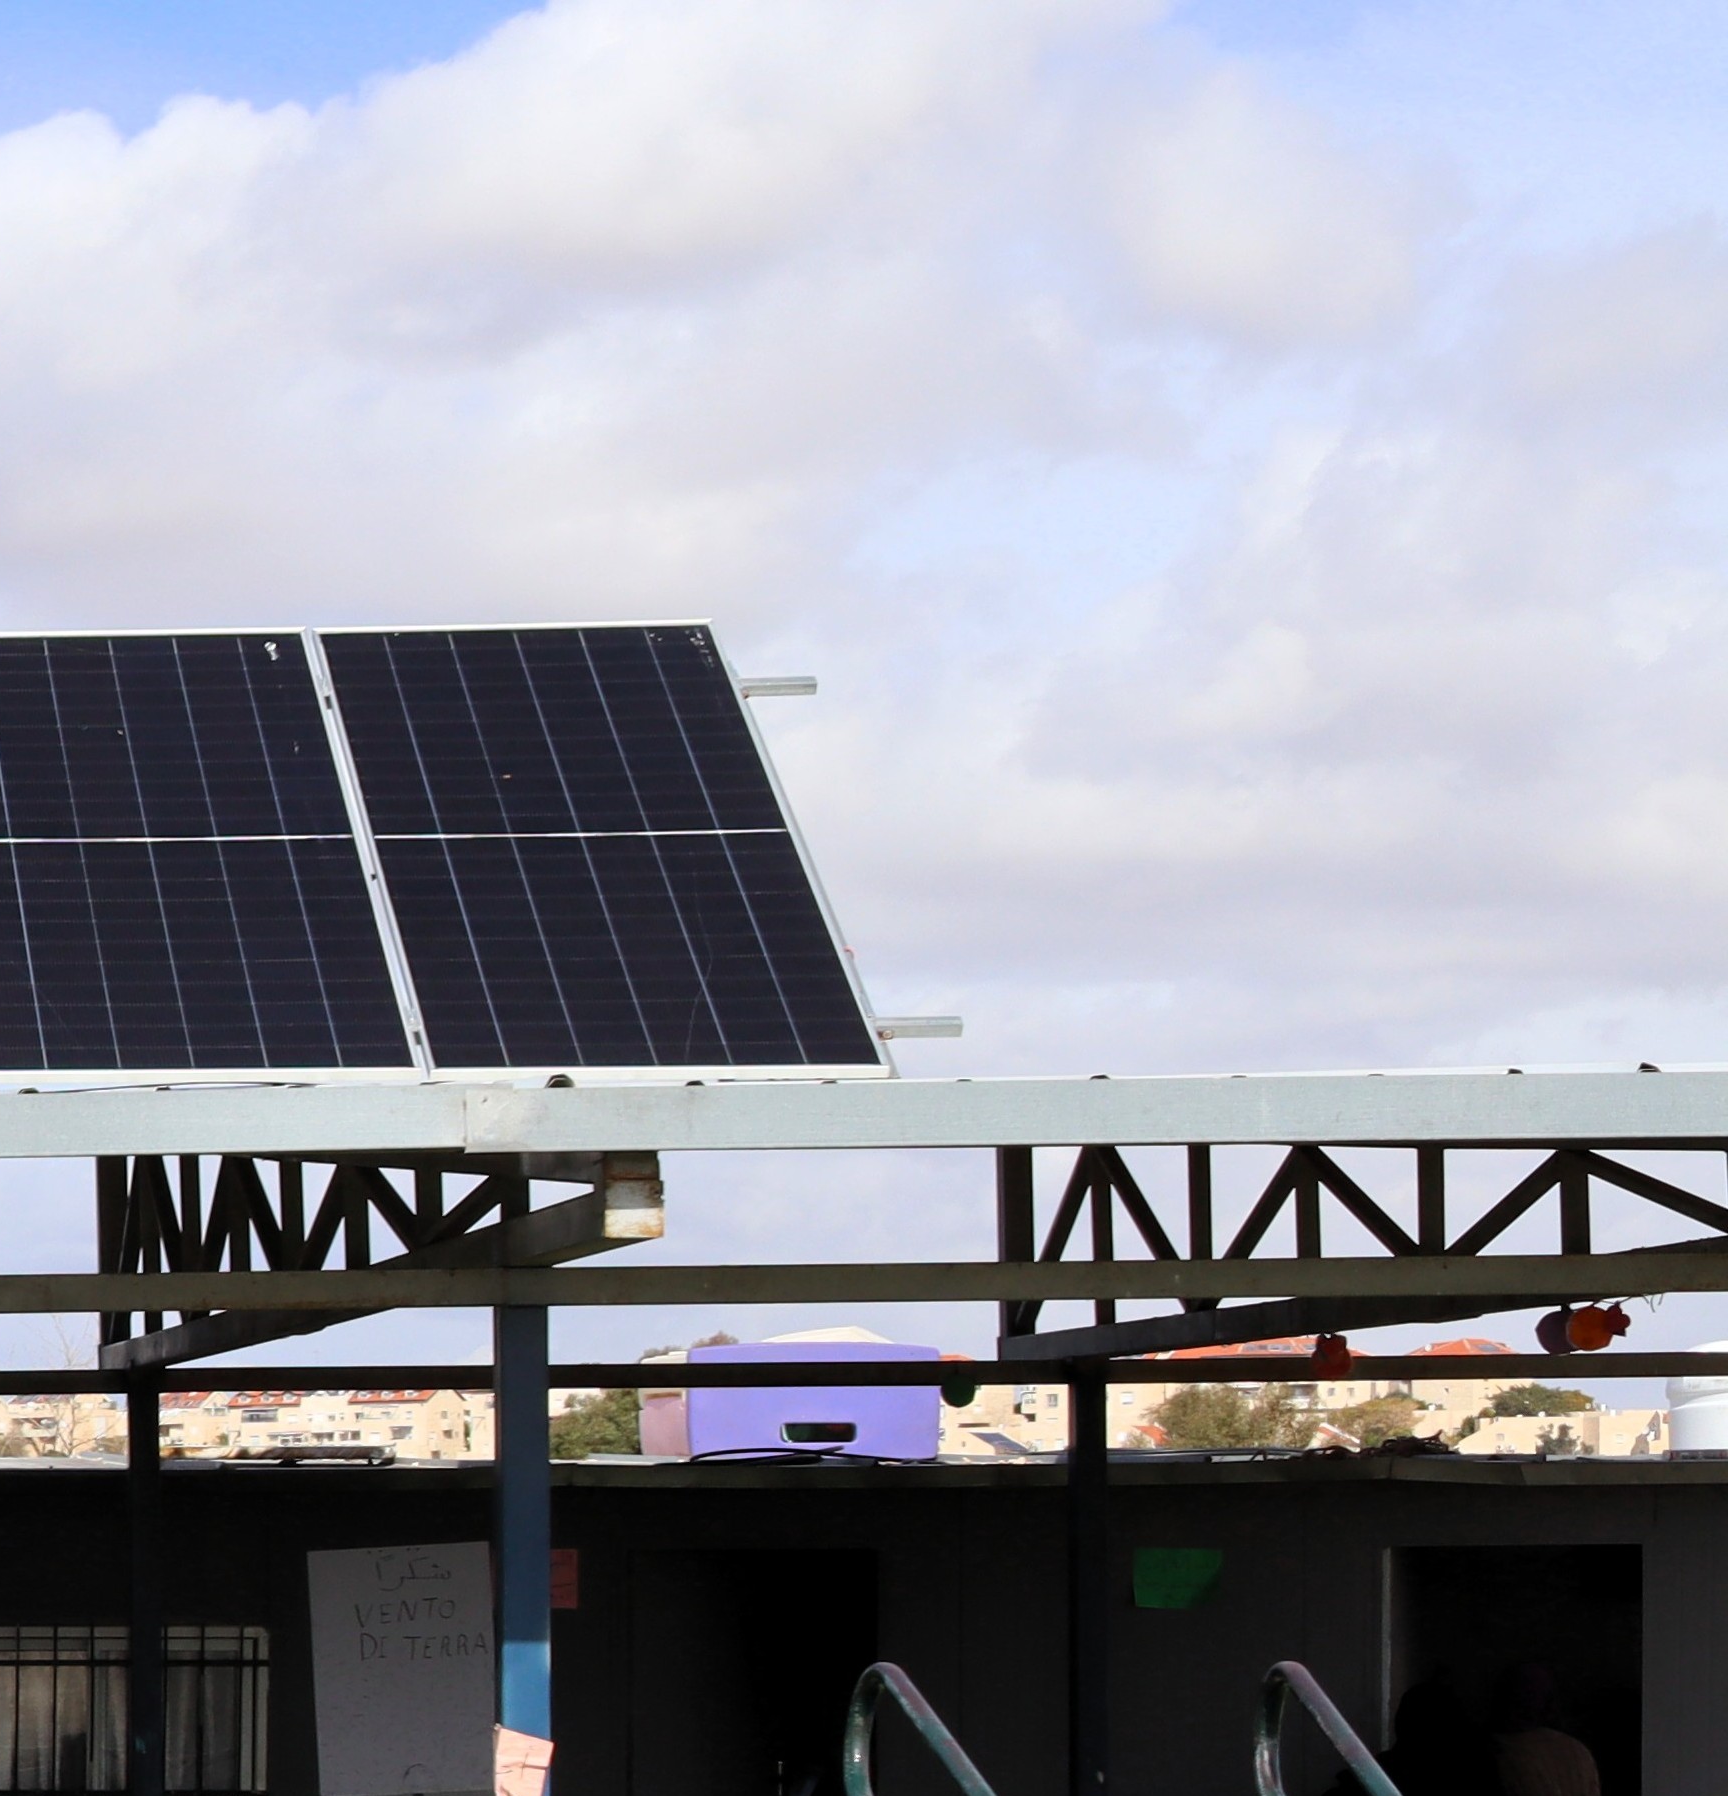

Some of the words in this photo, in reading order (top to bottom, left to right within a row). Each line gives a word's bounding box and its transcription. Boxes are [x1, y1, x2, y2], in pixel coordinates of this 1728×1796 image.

[355, 1597, 456, 1629] VENTO
[360, 1633, 388, 1661] DI
[403, 1632, 488, 1661] TERRA
